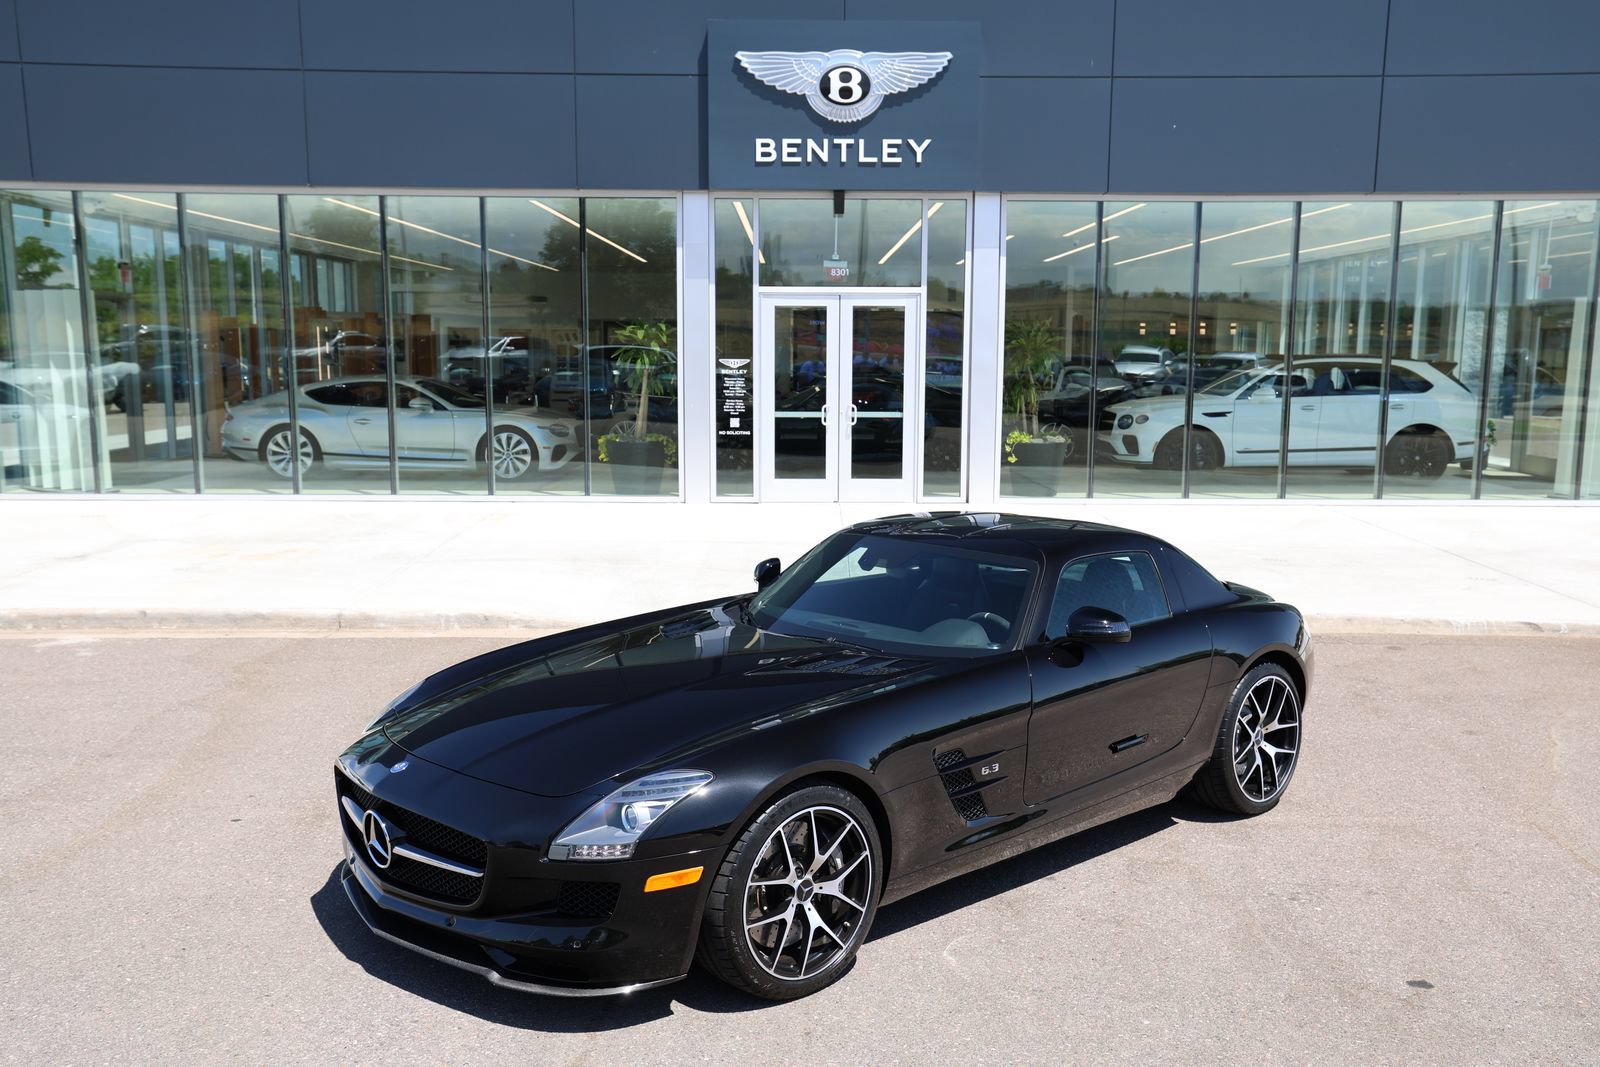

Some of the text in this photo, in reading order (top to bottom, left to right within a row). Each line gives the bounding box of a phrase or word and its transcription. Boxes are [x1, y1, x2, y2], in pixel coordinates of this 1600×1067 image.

[828, 67, 863, 104] B
[754, 138, 932, 163] BENTLEY
[831, 268, 849, 276] 8301
[981, 763, 999, 775] 6.3
